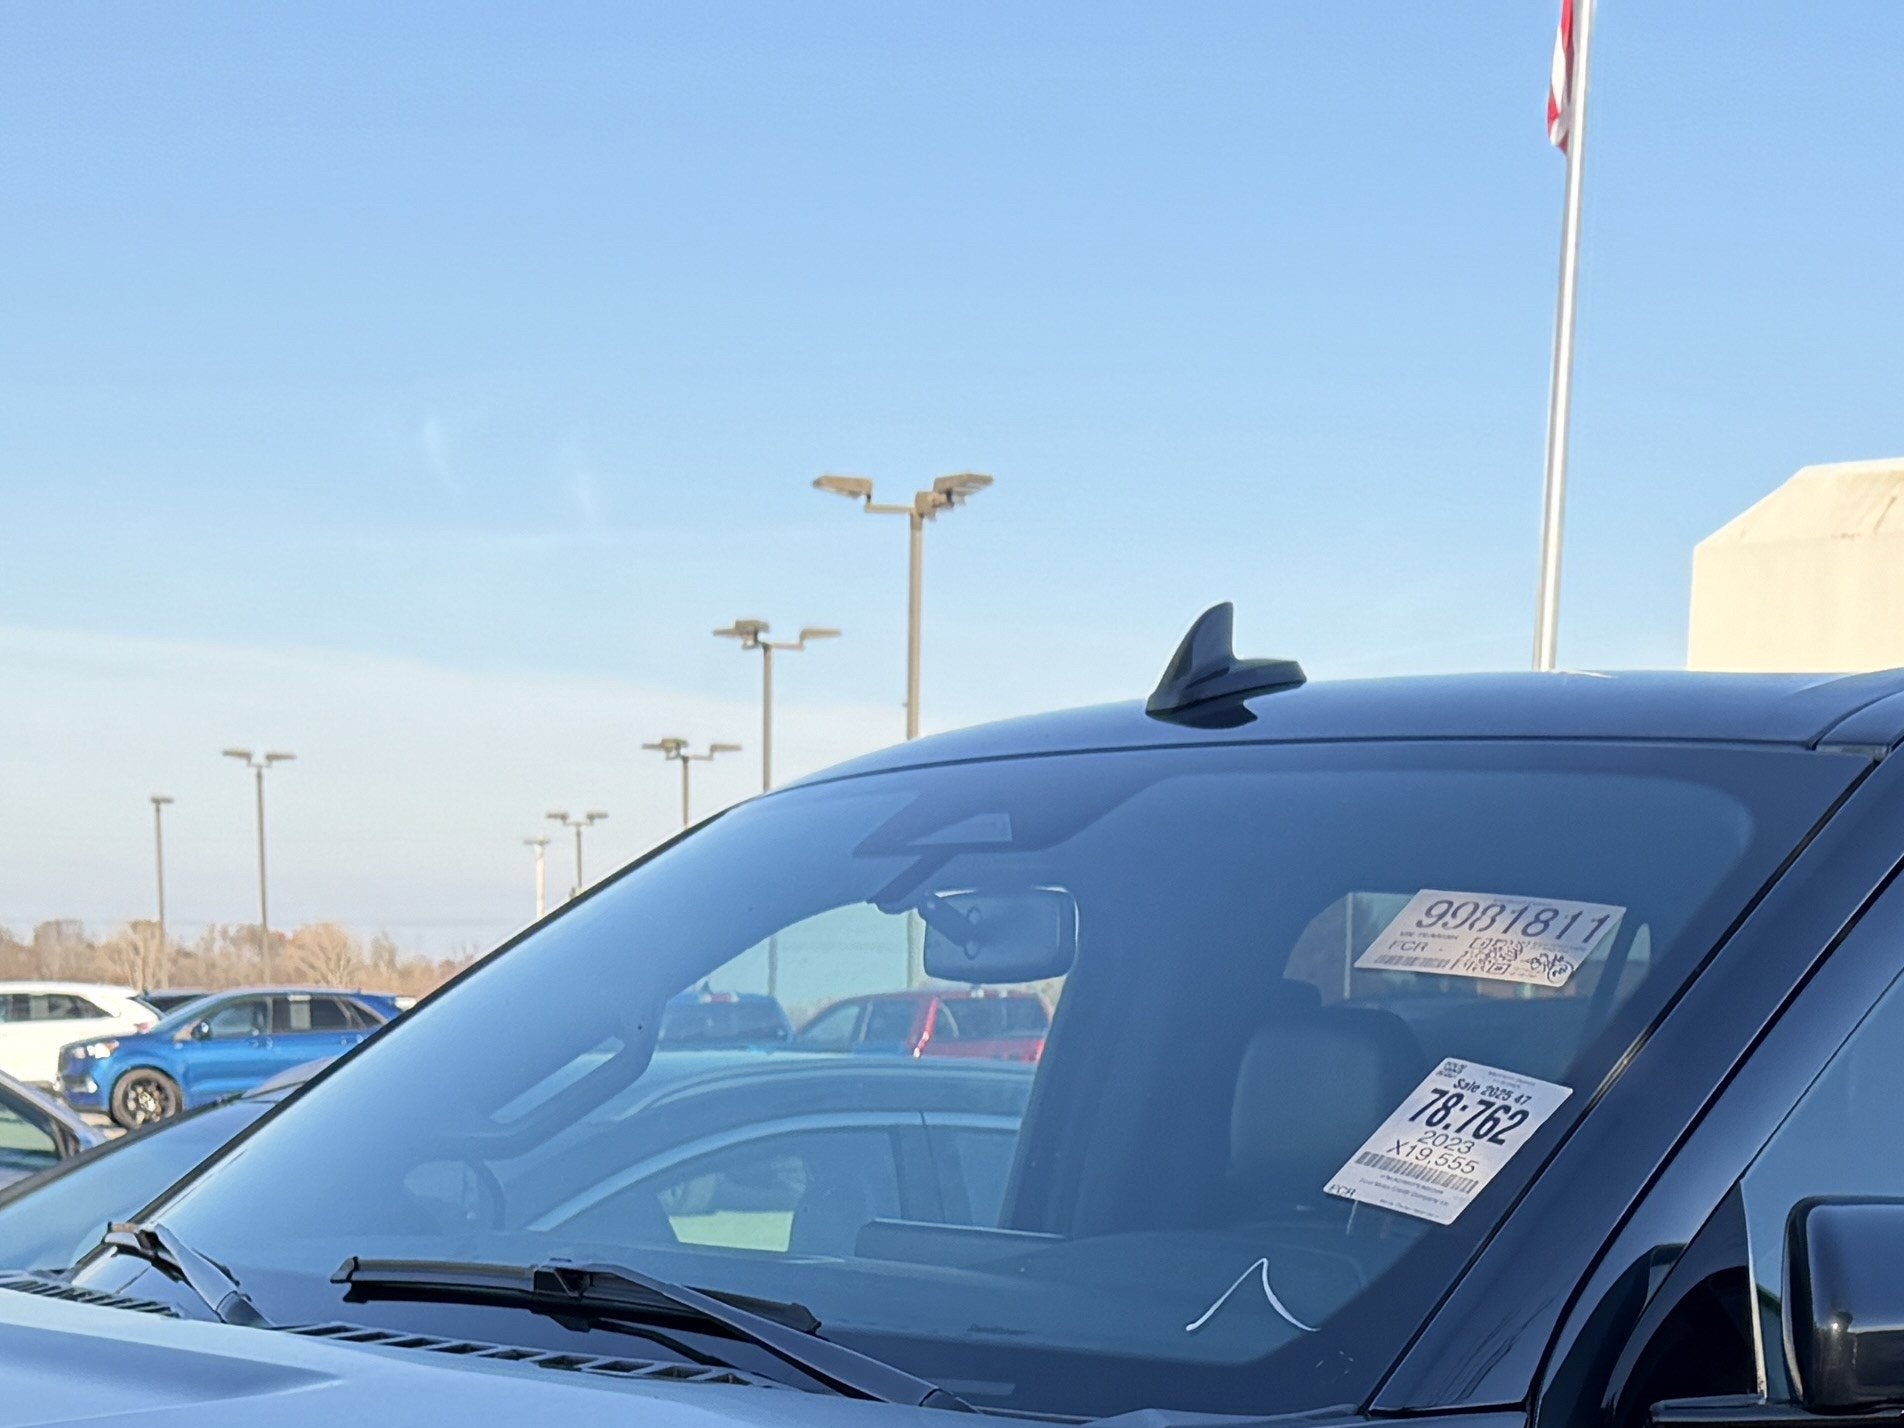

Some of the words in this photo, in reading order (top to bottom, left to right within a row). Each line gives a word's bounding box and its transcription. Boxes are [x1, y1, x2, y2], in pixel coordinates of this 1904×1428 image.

[1453, 1078, 1481, 1093] Sale
[1480, 1085, 1513, 1102] 2025
[1408, 1087, 1530, 1146] 78:762
[1387, 1139, 1480, 1175] X19,555
[1417, 1130, 1475, 1154] 2023
